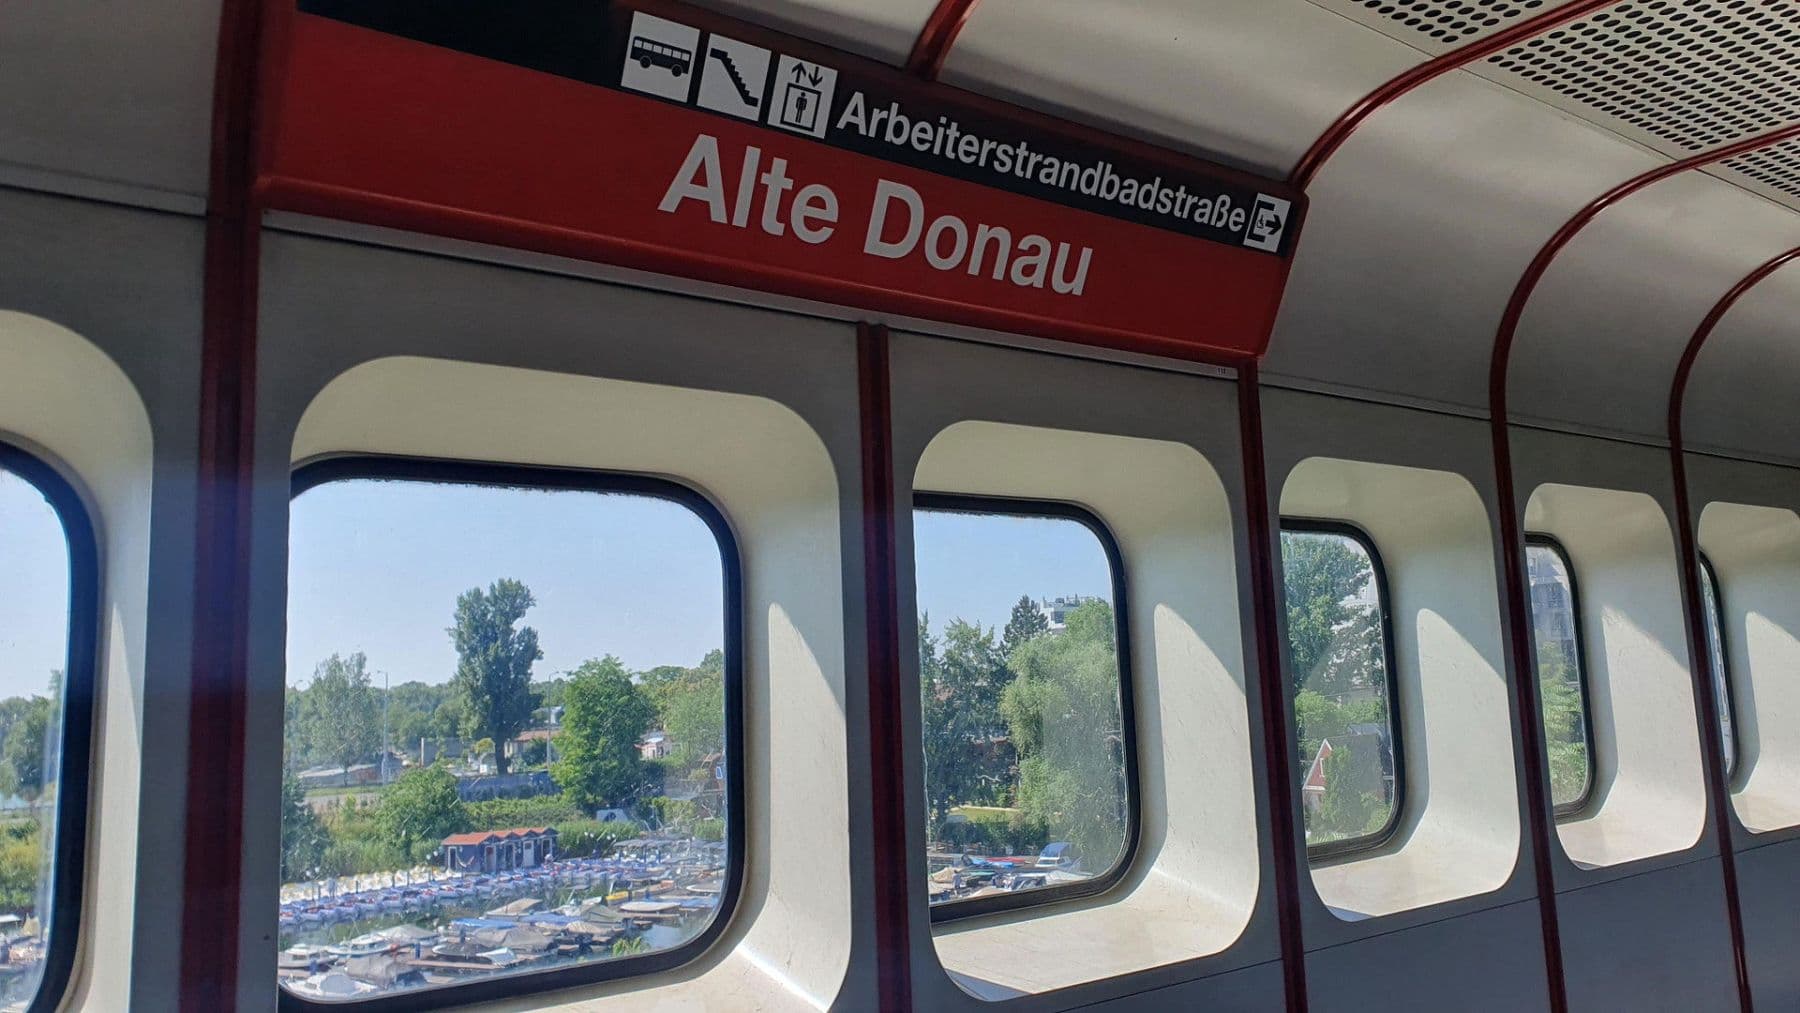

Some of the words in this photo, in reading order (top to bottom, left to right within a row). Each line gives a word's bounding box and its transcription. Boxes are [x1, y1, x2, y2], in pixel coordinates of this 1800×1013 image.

[658, 134, 839, 244] Alte
[864, 180, 1093, 296] Donau
[837, 91, 1246, 232] Arbeiterstrandbadstraße
